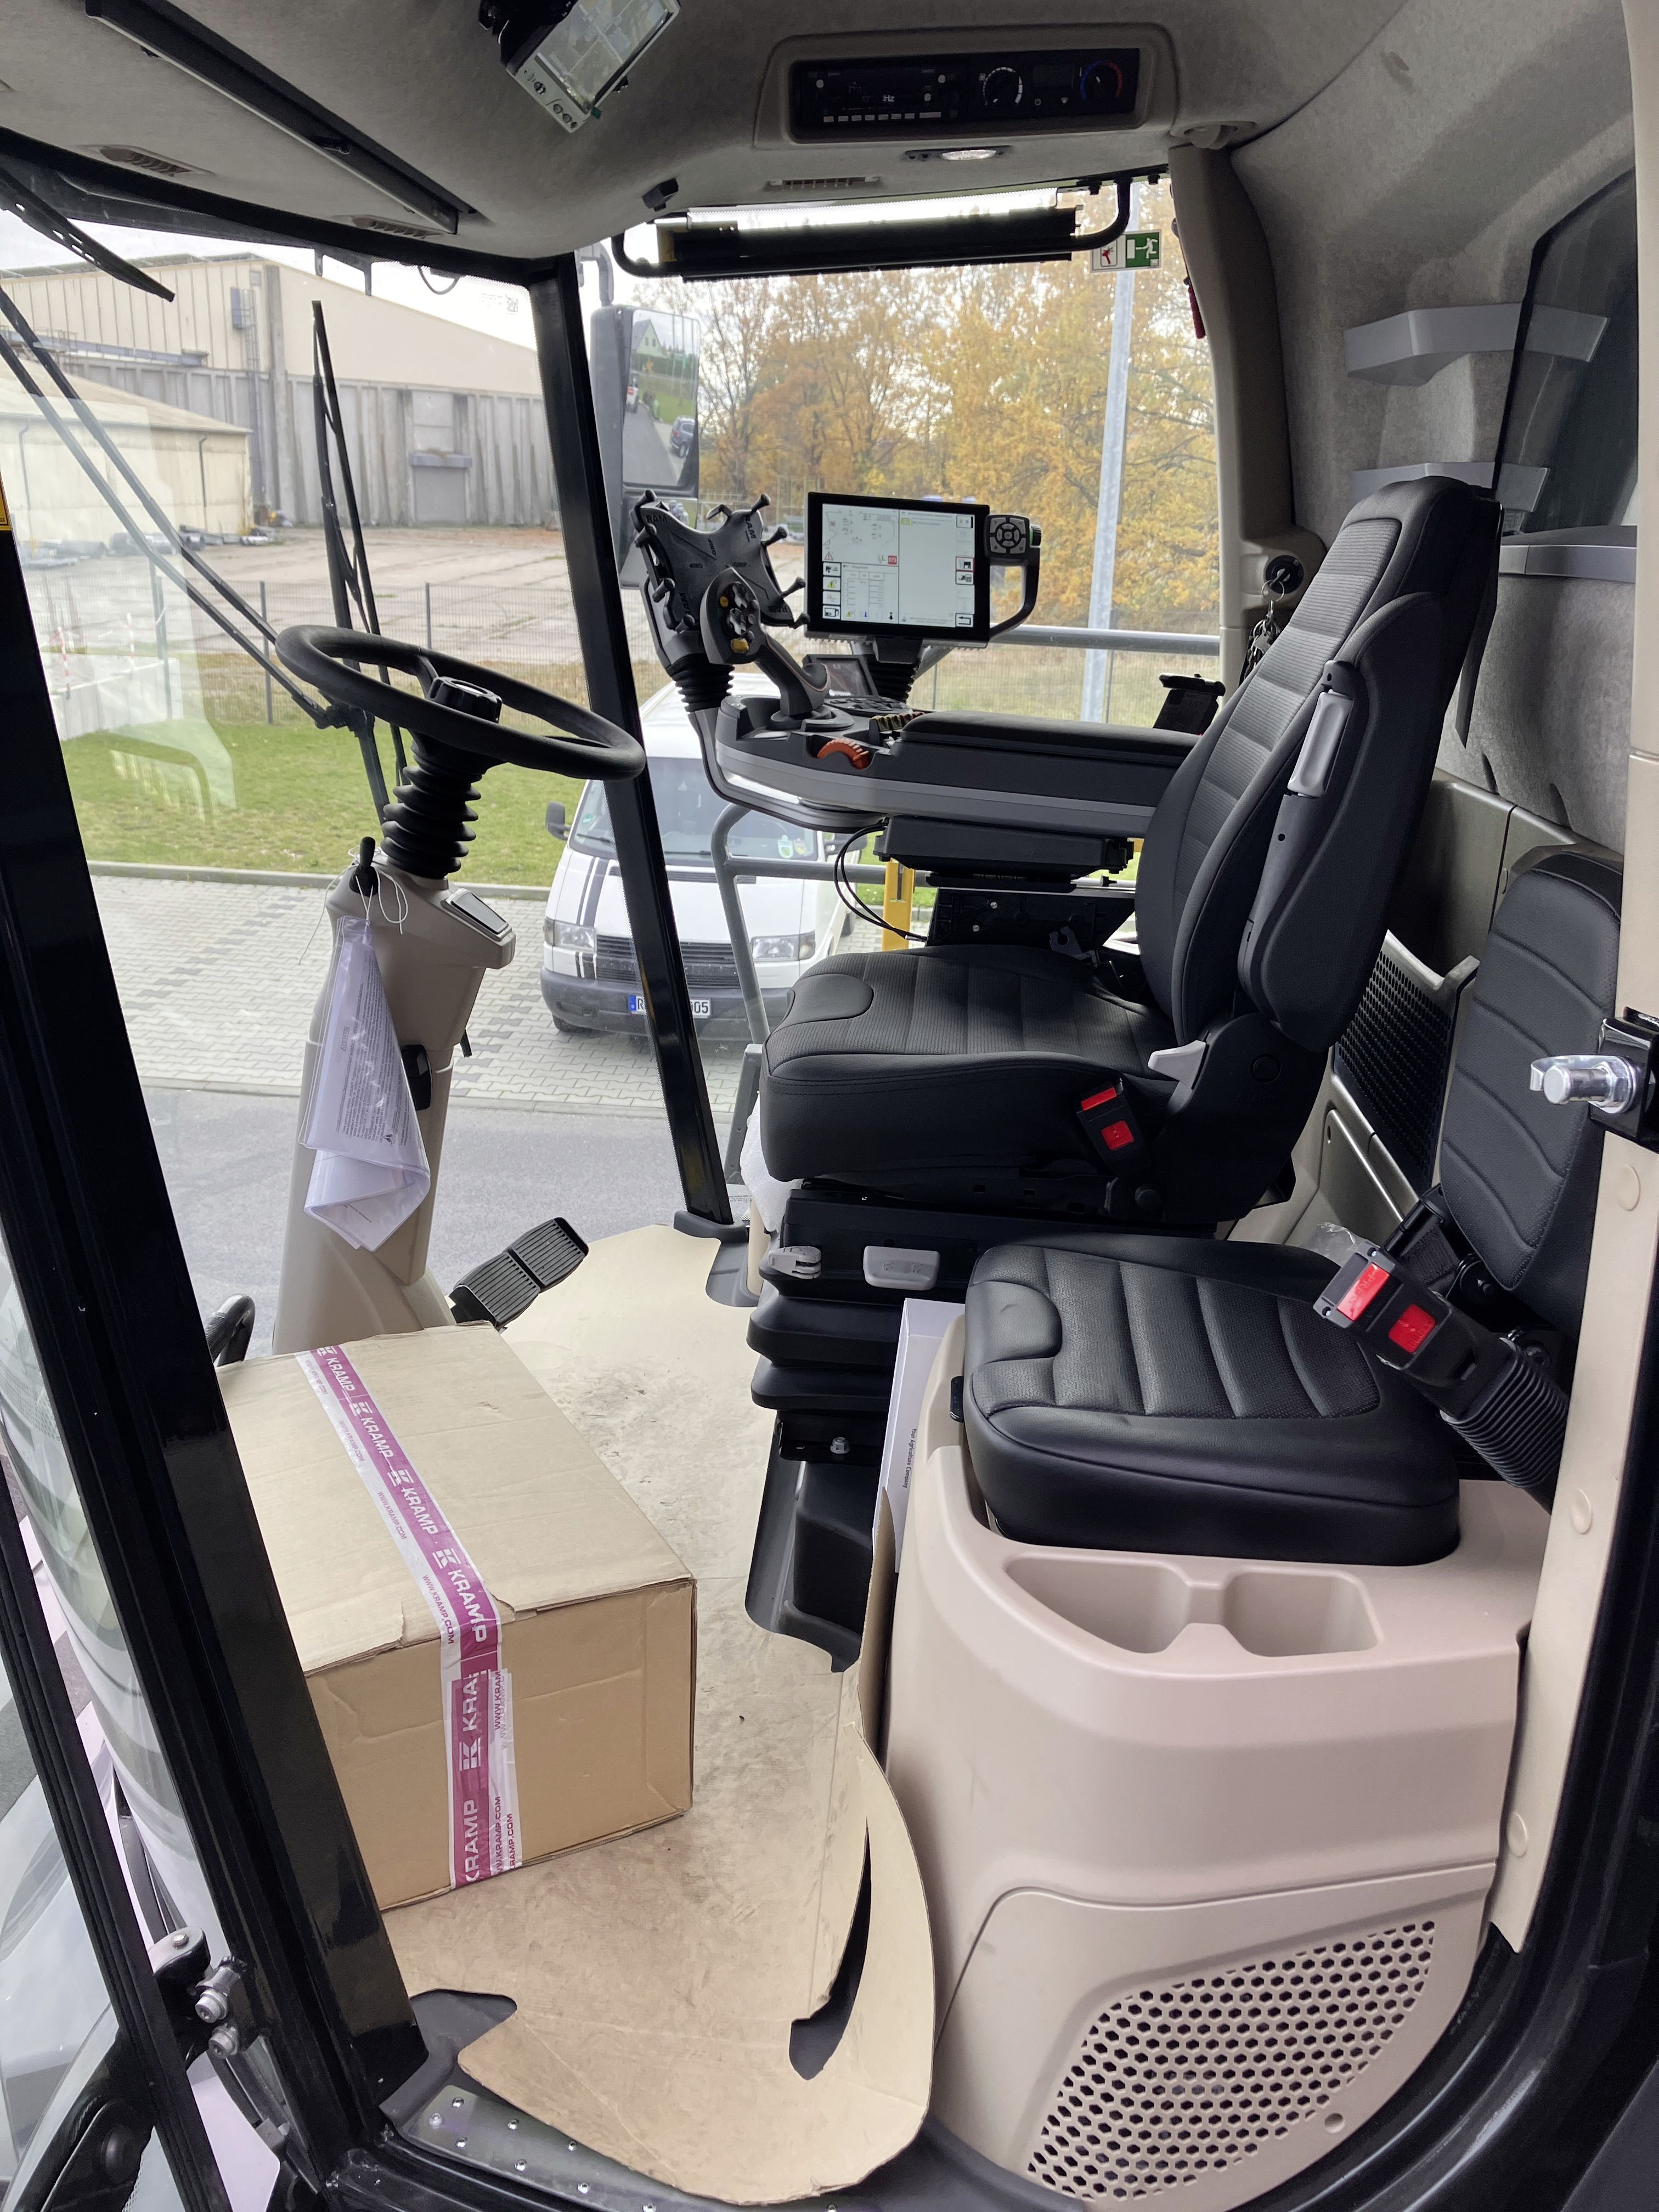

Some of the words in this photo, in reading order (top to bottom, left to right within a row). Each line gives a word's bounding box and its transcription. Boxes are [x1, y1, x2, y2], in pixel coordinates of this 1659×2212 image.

[646, 515, 668, 523] RAM
[326, 1357, 356, 1391] KRAMP
[338, 1420, 365, 1462] WWW.KRAMP.COM
[360, 1417, 394, 1458] KRAMP
[907, 1440, 916, 1466] Agriculture
[902, 1466, 911, 1488] Company
[377, 1491, 407, 1540] WWW.KRAMP.COM
[401, 1487, 438, 1535] KRAMP
[422, 1574, 455, 1644] WWW.KRAMP.COM
[448, 1568, 488, 1642] KRAMP
